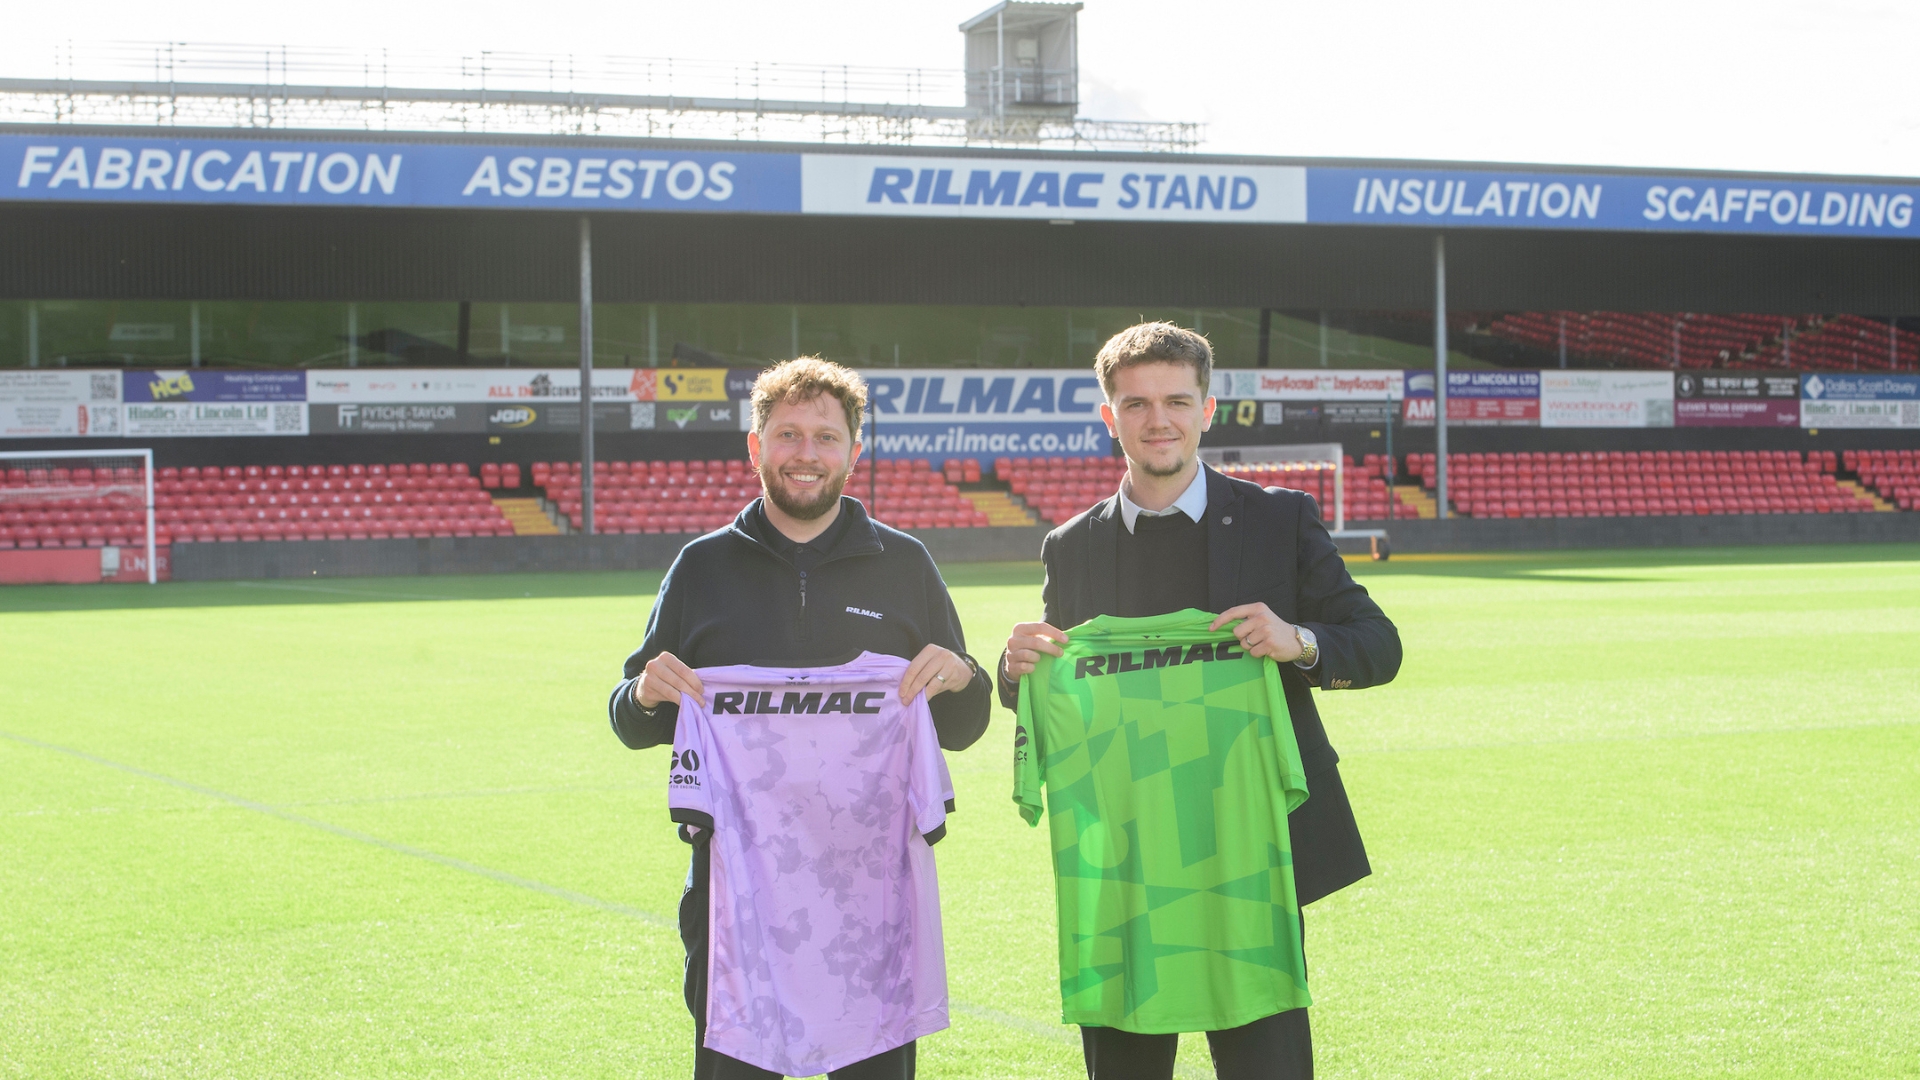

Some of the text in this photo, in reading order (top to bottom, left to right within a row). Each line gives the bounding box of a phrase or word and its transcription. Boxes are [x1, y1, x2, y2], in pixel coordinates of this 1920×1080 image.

[17, 146, 402, 195] FABRICATION
[461, 155, 737, 202] ASBESTOS
[866, 166, 1258, 211] RILMAC STAND
[1353, 177, 1602, 219] INSULATION
[1643, 185, 1914, 229] SCAFFOLDING
[148, 373, 195, 400] HCG
[488, 386, 514, 397] ALL
[552, 386, 628, 397] CONSUCTION
[1448, 373, 1471, 385] RSP
[1472, 373, 1518, 386] LINCOLN
[1519, 374, 1539, 386] LTD
[1825, 378, 1918, 396] Dallas Scott Davey
[866, 377, 1101, 414] RILMAC
[128, 406, 176, 420] Hindles
[196, 405, 243, 419] Lincoln
[247, 405, 268, 419] Ltd
[710, 408, 731, 421] UK
[862, 426, 1100, 453] www.rilmac.co.uk
[124, 556, 168, 571] LNR
[845, 606, 883, 620] RILMAC
[1074, 640, 1245, 680] RILMAC
[712, 691, 886, 715] RILMAC
